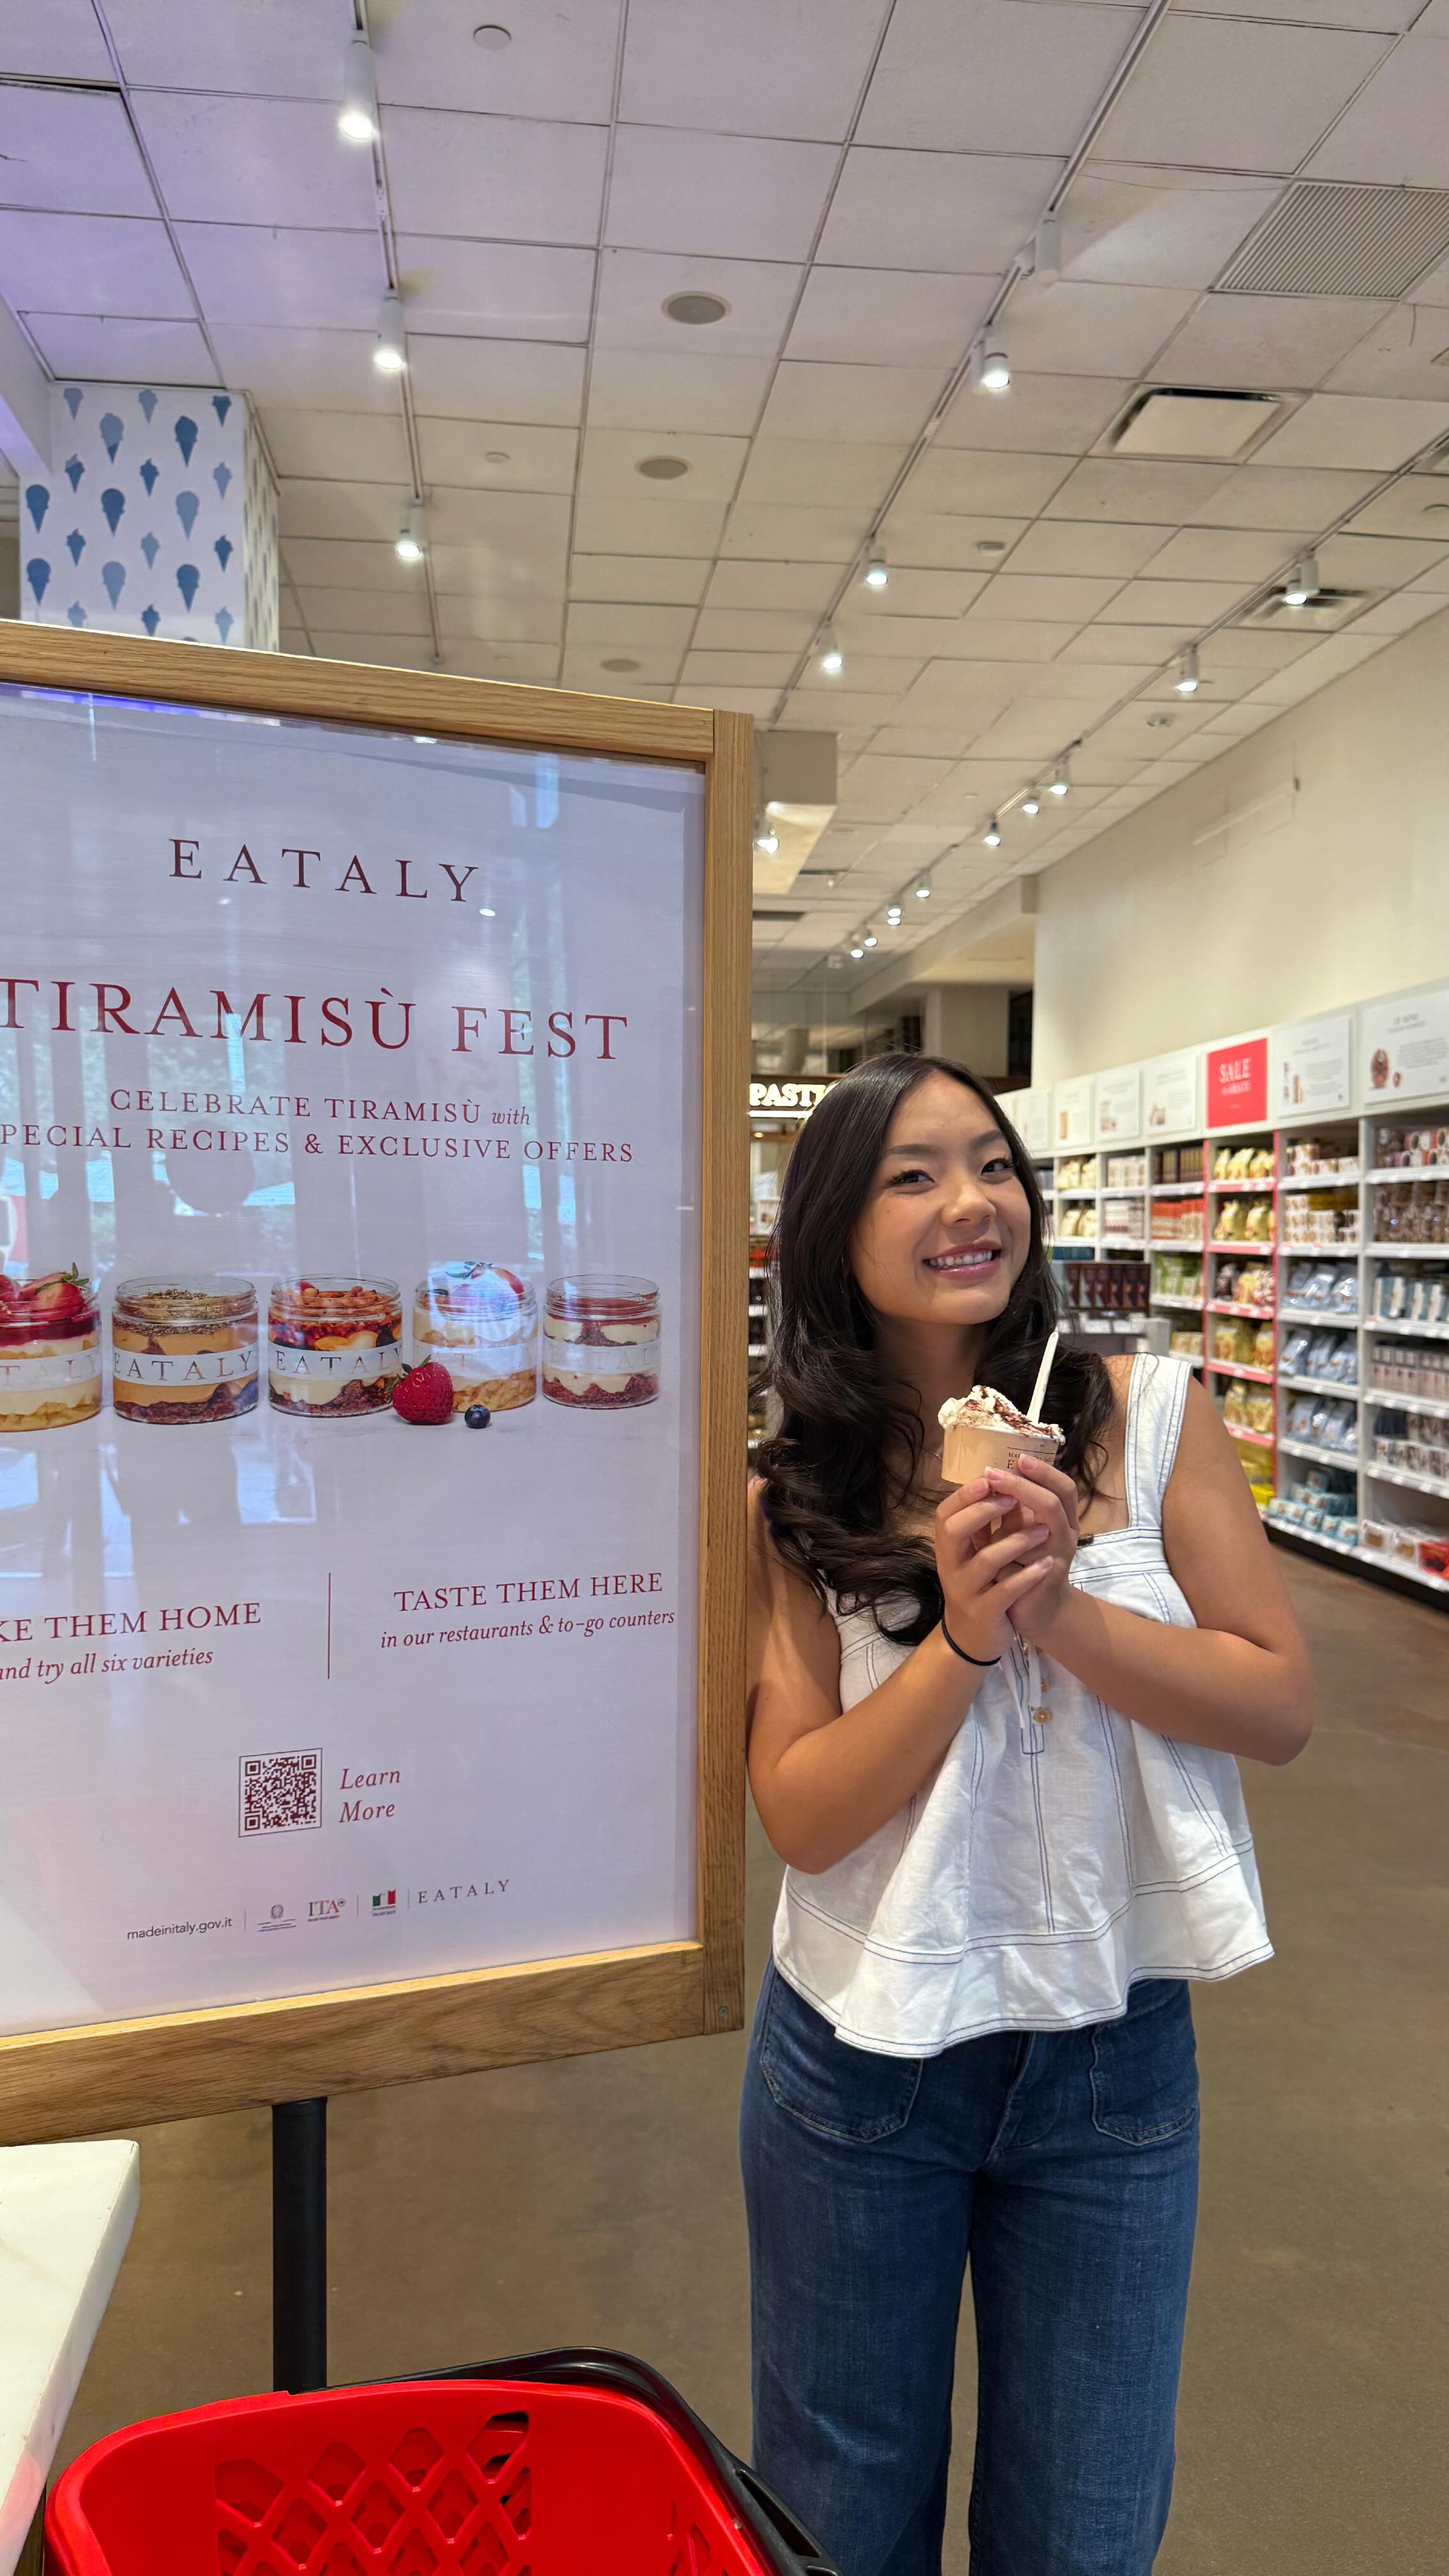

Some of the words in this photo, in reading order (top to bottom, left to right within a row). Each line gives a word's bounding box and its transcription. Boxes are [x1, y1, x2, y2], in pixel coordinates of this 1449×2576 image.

[169, 839, 479, 903] EATALY
[0, 978, 417, 1050] TIRAMISÙ
[451, 1006, 628, 1060] FEST
[1219, 1058, 1250, 1084] SALE
[110, 1089, 311, 1118] CELEBRATE
[324, 1098, 480, 1124] TIRAMISÙ
[491, 1106, 531, 1126] with
[749, 1083, 838, 1107] PASTI
[146, 1128, 289, 1154] RECIPES
[305, 1133, 324, 1154] &
[338, 1135, 511, 1160] EXCLUSIVE
[524, 1140, 633, 1163] OFFERS
[113, 1350, 252, 1382] EATALY
[394, 1585, 487, 1611] TASTE
[496, 1578, 581, 1604] THEM
[590, 1572, 663, 1597] HERE
[44, 1611, 148, 1639] THEM
[158, 1602, 261, 1631] HOME
[381, 1631, 397, 1648] in
[403, 1632, 434, 1646] our
[439, 1620, 533, 1643] restaurants
[539, 1614, 553, 1634] &
[558, 1617, 604, 1637] to-go
[609, 1610, 675, 1629] counters
[36, 1660, 64, 1685] try
[70, 1653, 96, 1675] all
[101, 1648, 128, 1672] six
[132, 1647, 214, 1670] varieties
[339, 1768, 401, 1790] Learn
[339, 1800, 395, 1823] More
[418, 1879, 510, 1904] EATALY
[308, 1900, 339, 1917] ITA
[127, 1917, 233, 1940] madeinitaly.gov.it
